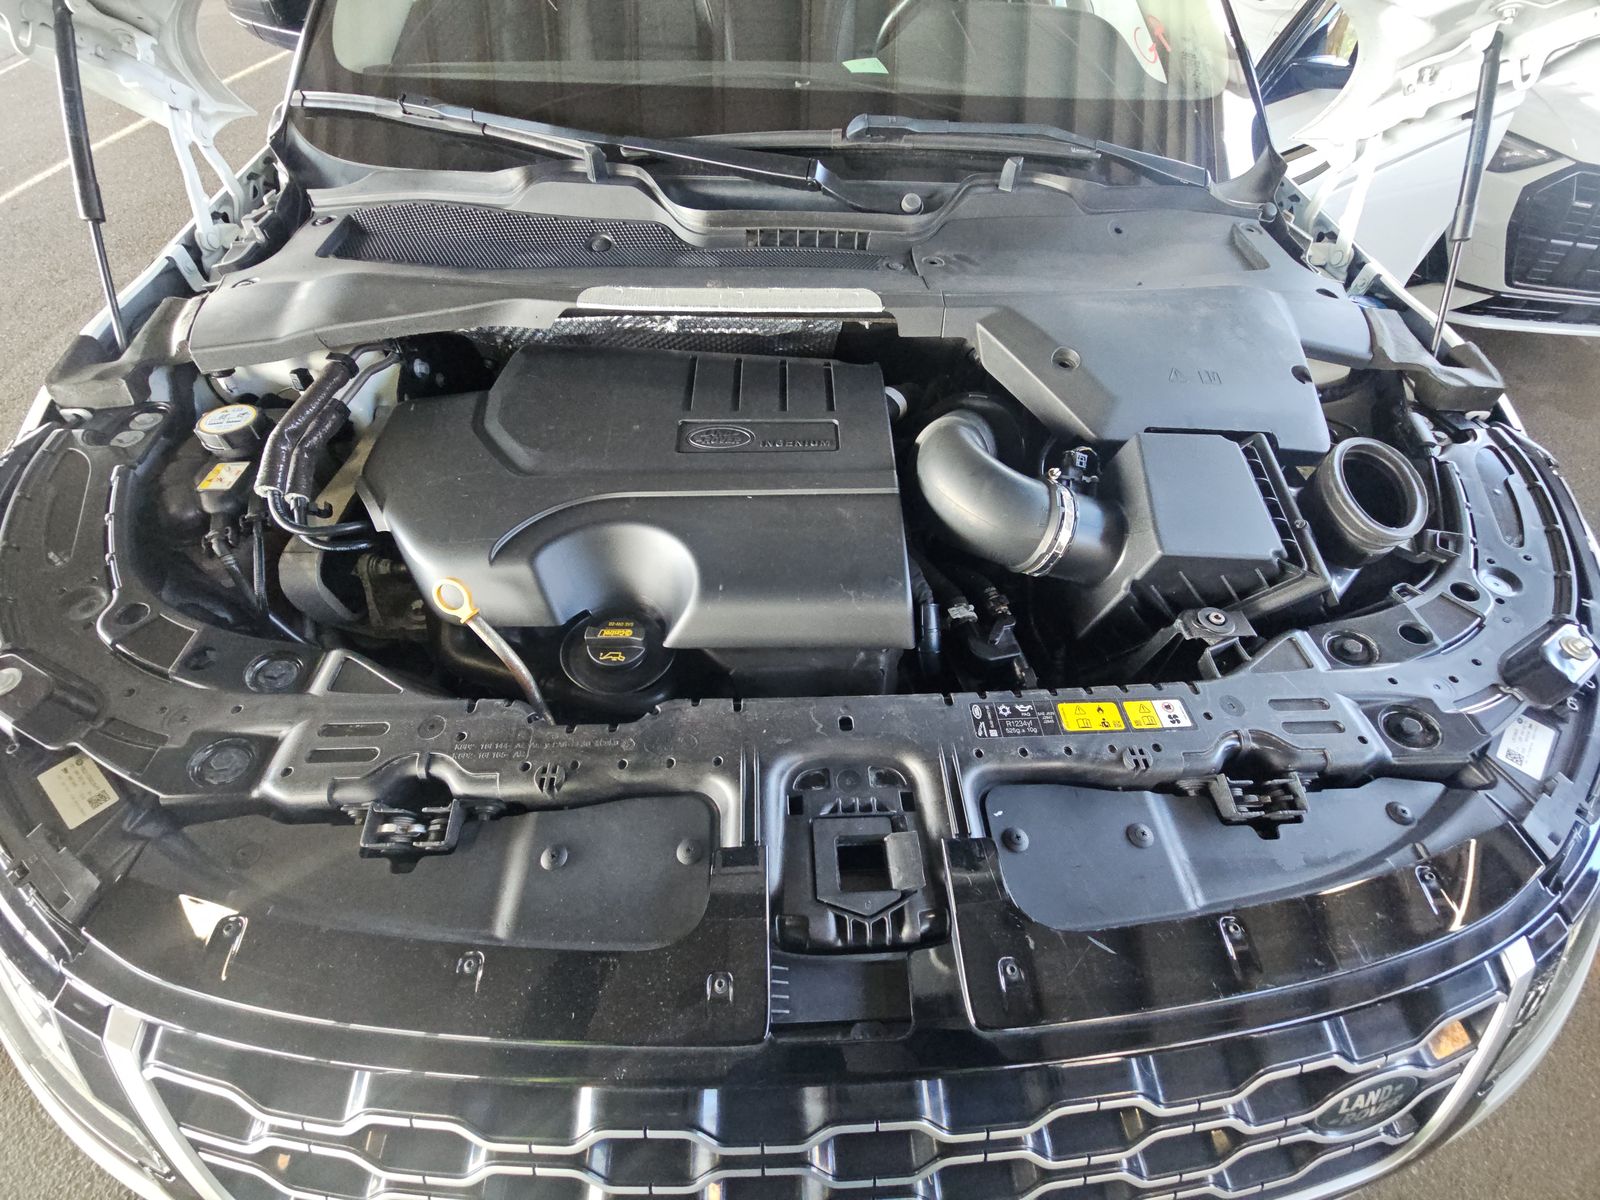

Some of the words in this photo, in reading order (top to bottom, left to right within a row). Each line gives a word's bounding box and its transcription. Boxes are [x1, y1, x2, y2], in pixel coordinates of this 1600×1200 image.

[759, 440, 831, 448] INGENIUM
[1005, 720, 1033, 728] R1234yf
[1338, 1085, 1392, 1114] LAND
[1344, 1095, 1403, 1123] ROVER
